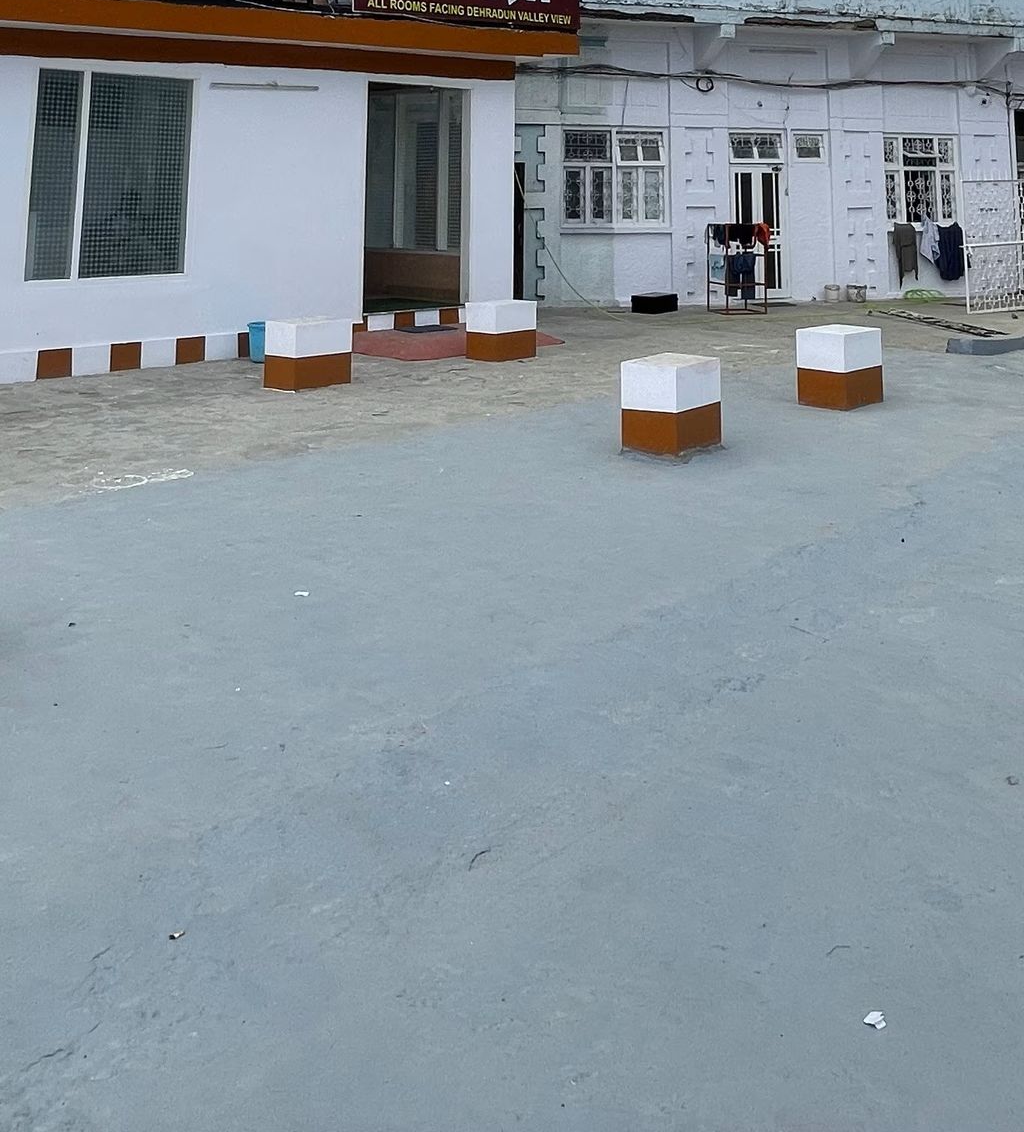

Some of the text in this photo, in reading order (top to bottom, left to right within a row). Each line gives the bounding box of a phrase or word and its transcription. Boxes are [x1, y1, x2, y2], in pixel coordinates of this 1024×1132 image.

[390, 0, 427, 12] ROOMS
[429, 3, 465, 17] FACING
[466, 6, 516, 21] DEHRADUN
[517, 11, 550, 24] VALLEY
[551, 14, 572, 25] VIEW
